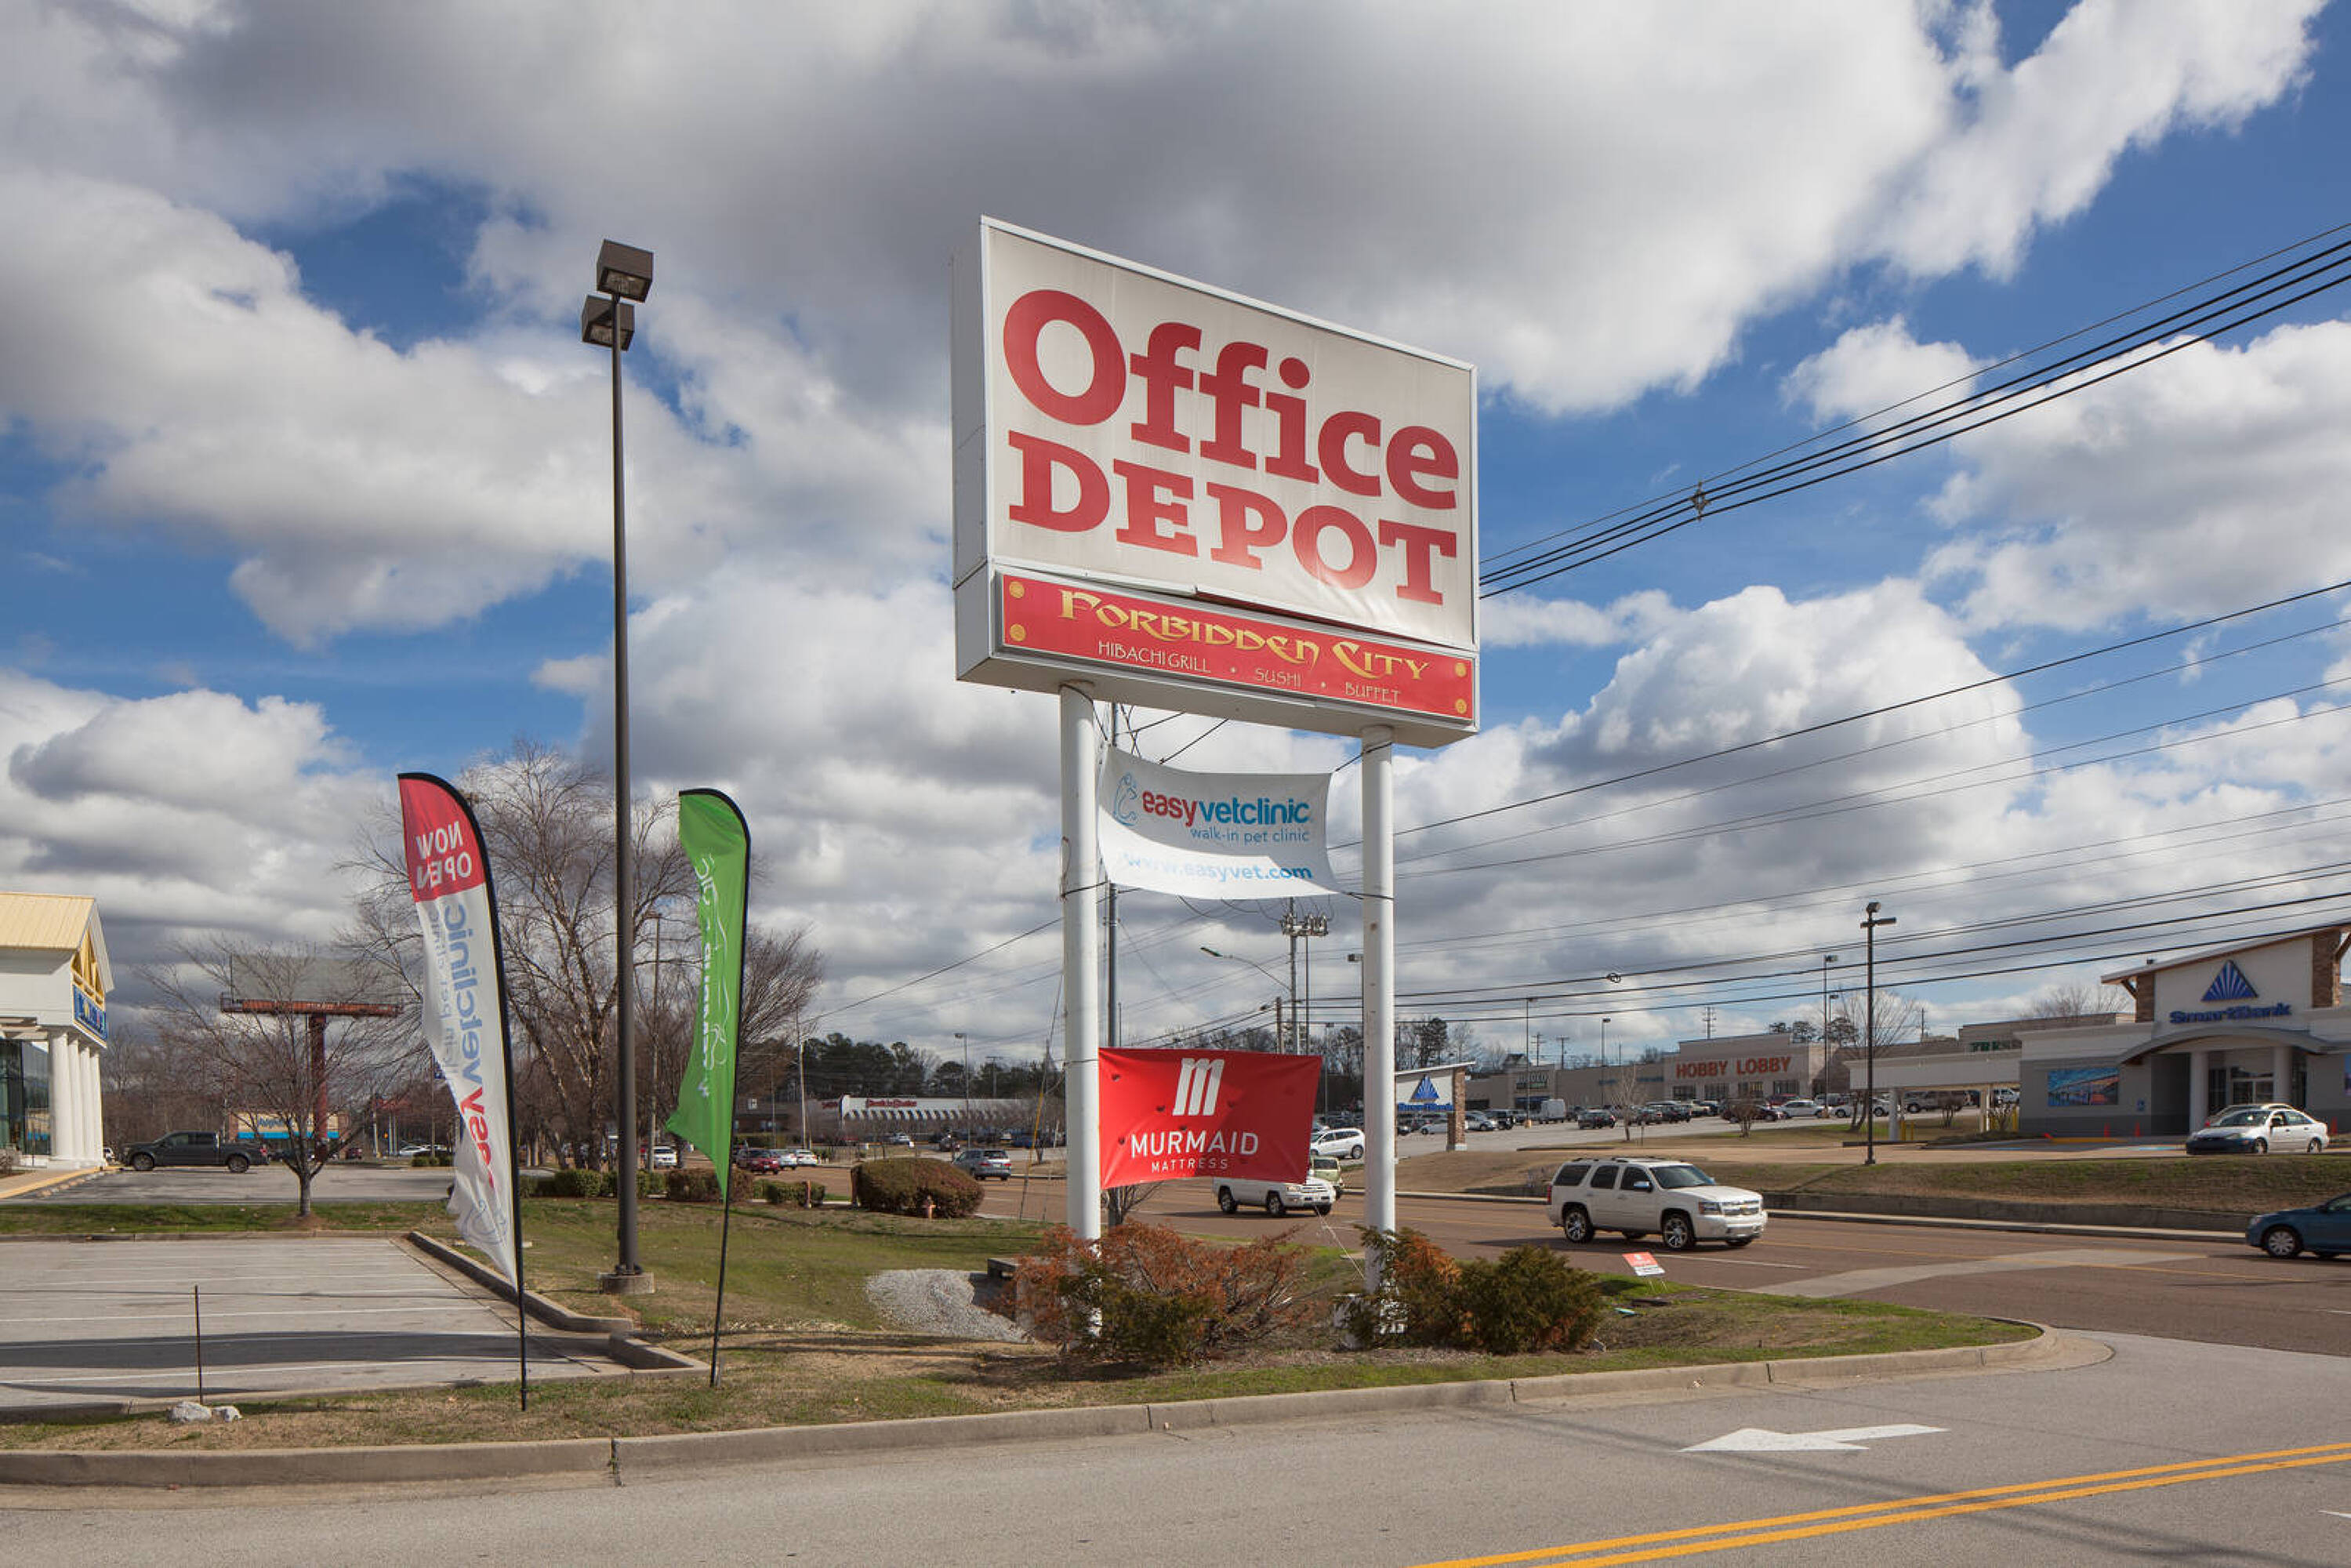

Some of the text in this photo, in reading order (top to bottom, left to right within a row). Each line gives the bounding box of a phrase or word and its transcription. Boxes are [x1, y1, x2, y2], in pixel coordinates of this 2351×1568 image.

[1003, 289, 1459, 510] Office
[1008, 430, 1457, 605] DEPOT
[1256, 667, 1301, 688] SUSHI
[1345, 681, 1400, 704] BUFFET
[1142, 790, 1312, 827] easyvetclinic
[1191, 827, 1310, 846] walk-in pet clinic
[1676, 1057, 1791, 1079] HOBBY LOBBY
[1130, 1131, 1259, 1159] MURMAID
[1152, 1158, 1228, 1174] MATTRESS
